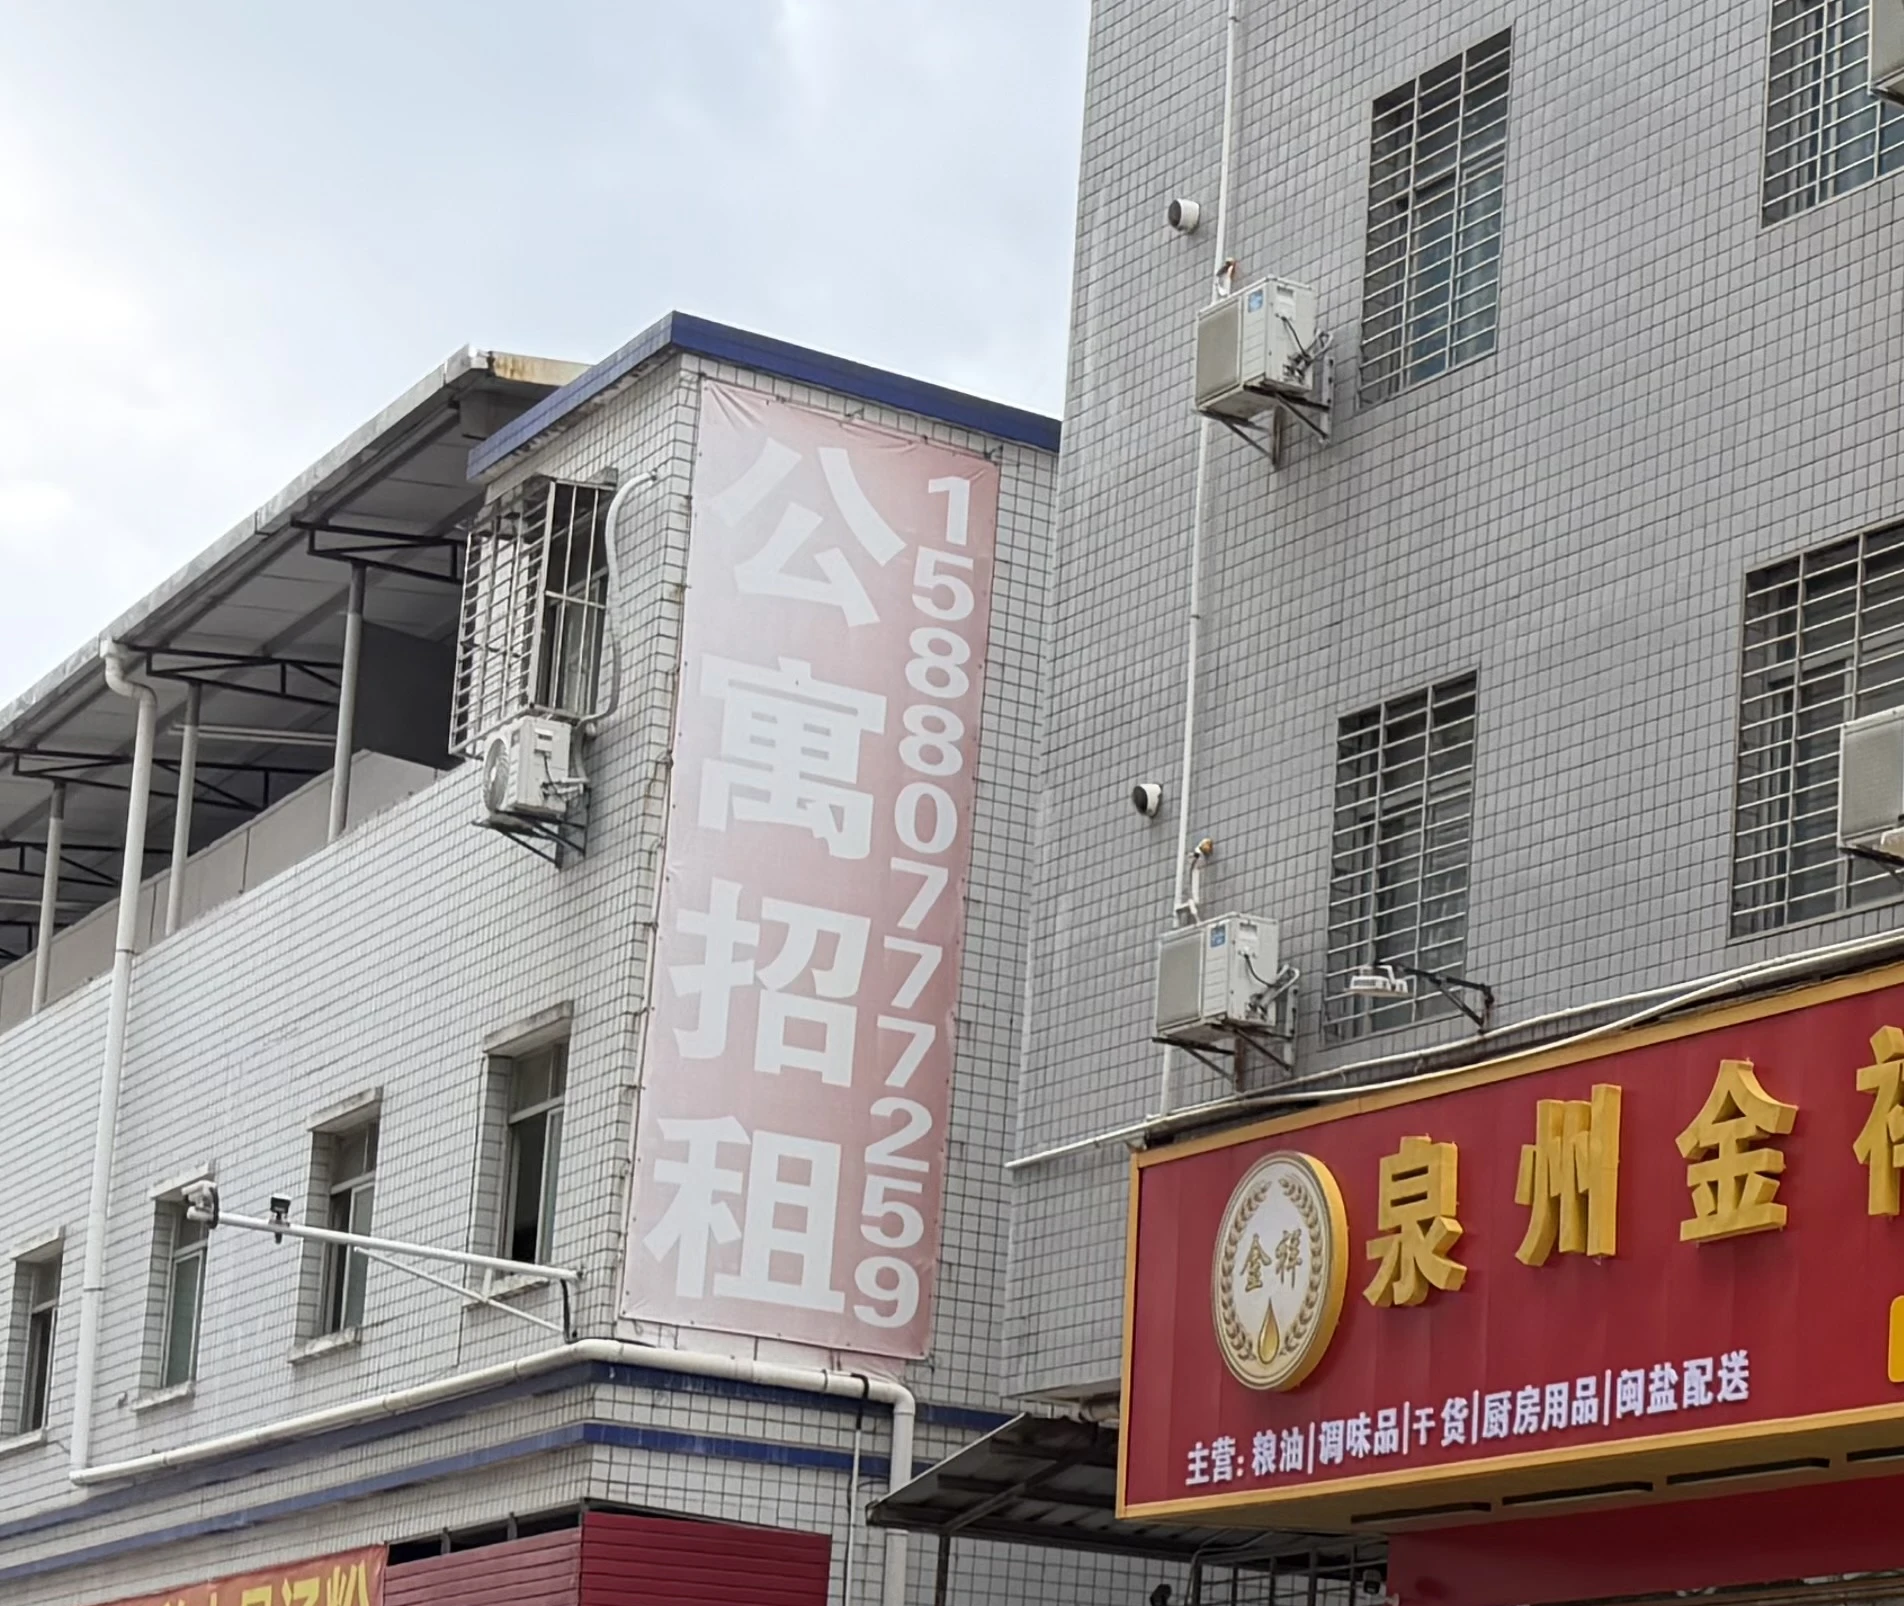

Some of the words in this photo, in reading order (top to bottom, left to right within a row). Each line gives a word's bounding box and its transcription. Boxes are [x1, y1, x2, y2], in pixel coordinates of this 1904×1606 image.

[645, 436, 907, 1316] 公寓招租
[852, 473, 976, 1329] 15880777259
[1239, 1228, 1303, 1293] 金祥
